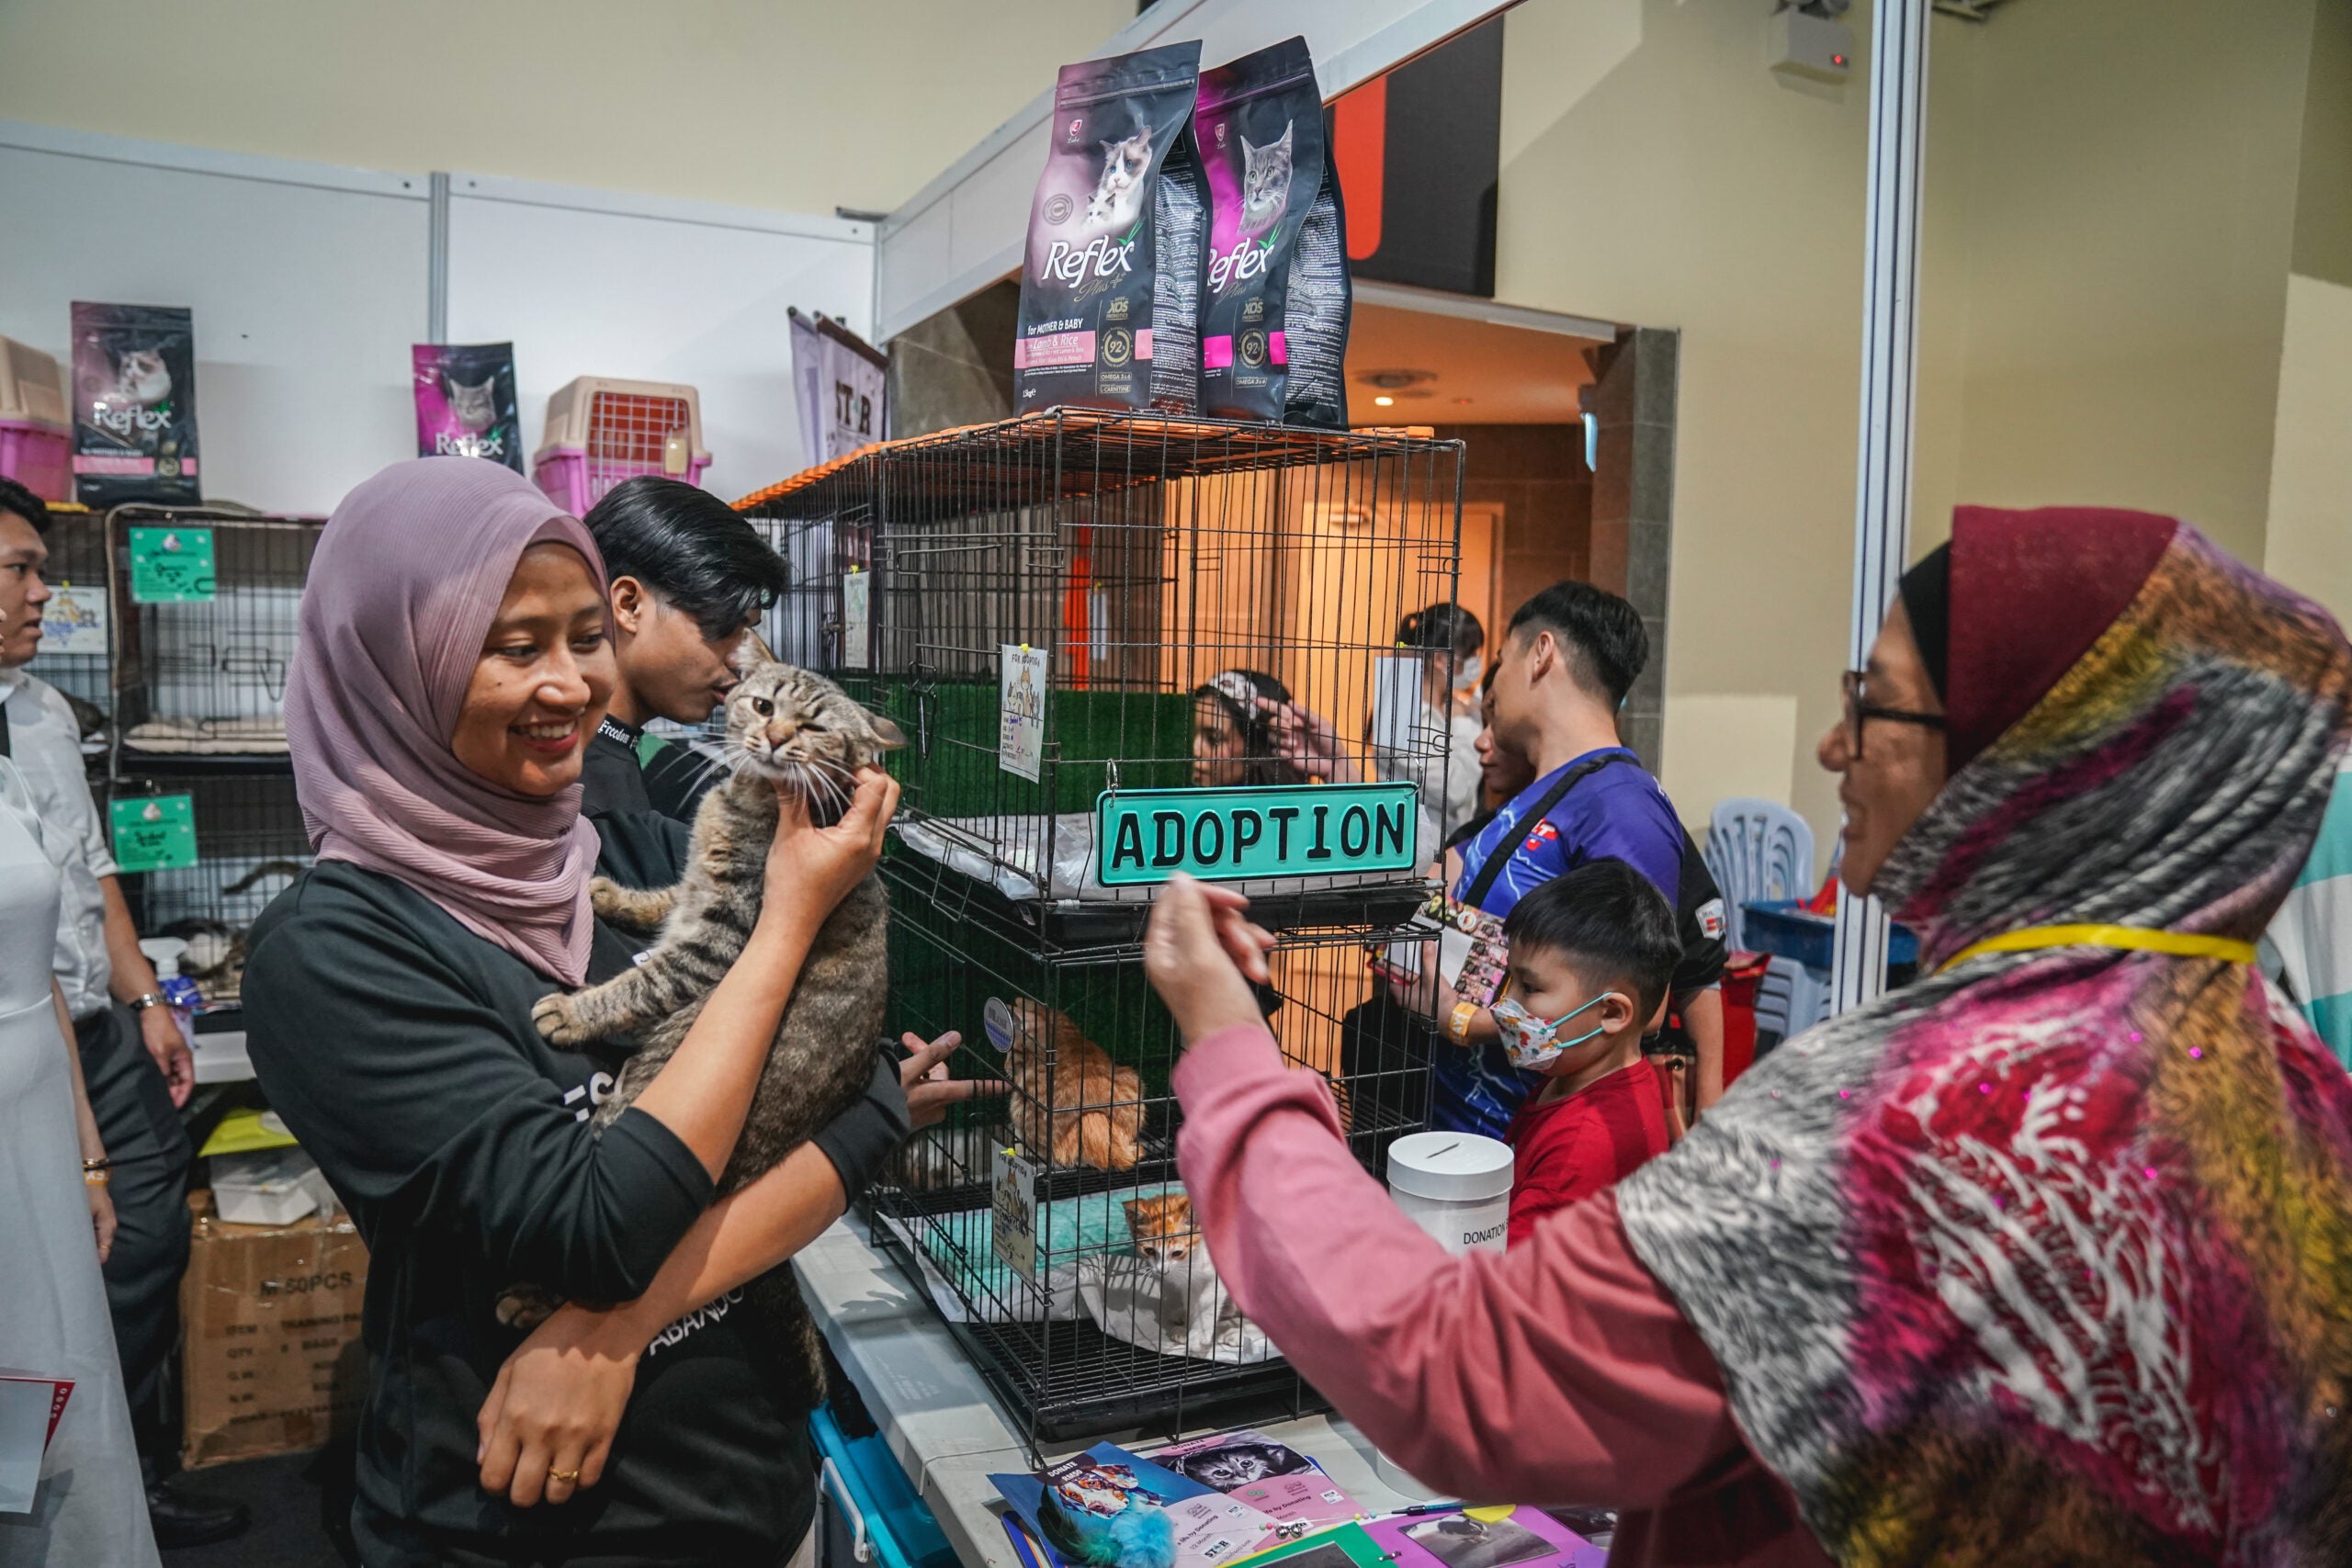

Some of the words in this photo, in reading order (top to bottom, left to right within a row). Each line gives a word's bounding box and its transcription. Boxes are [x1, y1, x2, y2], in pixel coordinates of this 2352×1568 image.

[1042, 234, 1136, 288] Reflex
[1107, 300, 1130, 313] XOS
[1244, 301, 1263, 315] XOS
[1037, 321, 1057, 334] MOTHER
[1064, 318, 1084, 330] BABY
[1033, 337, 1051, 350] Lamb
[1052, 336, 1058, 346] &
[1060, 334, 1079, 346] Rice
[94, 401, 172, 435] Reflex
[435, 432, 503, 457] Reflex
[1111, 803, 1406, 869] ADOPTION
[1464, 1221, 1505, 1244] DONATION
[1047, 1461, 1078, 1477] DONATE
[1062, 1469, 1083, 1482] RM50
[1282, 1495, 1312, 1508] Donating
[1194, 1514, 1219, 1533] Donating
